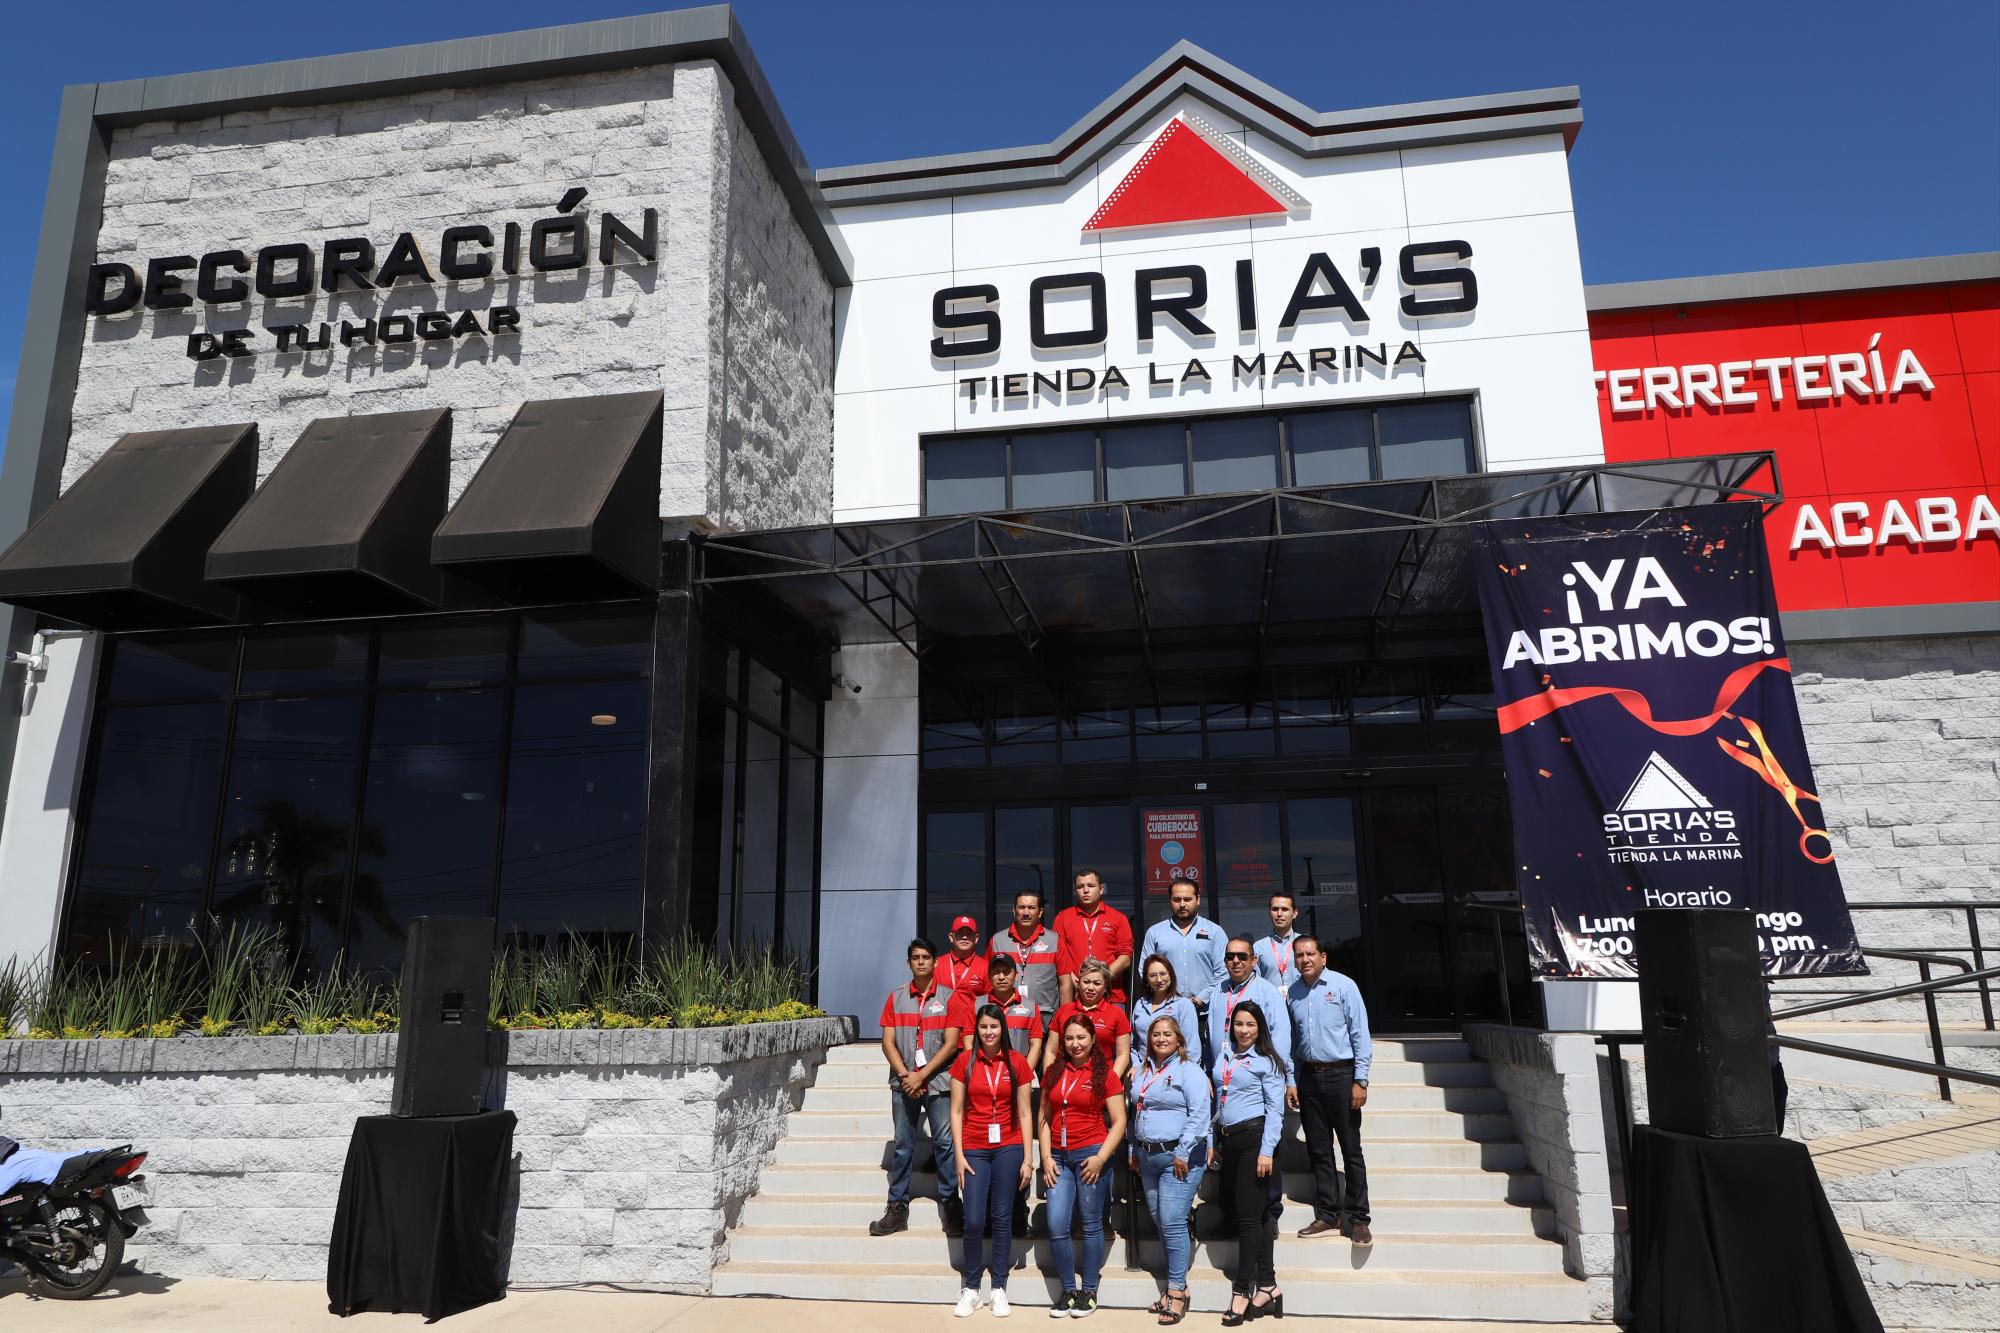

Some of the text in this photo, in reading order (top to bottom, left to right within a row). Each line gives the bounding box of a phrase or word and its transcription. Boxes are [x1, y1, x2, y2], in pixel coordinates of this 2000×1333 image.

[88, 187, 658, 316] DECORACIÓN
[930, 239, 1479, 360] SORIA'S
[186, 304, 521, 361] DE TU HOGAR
[960, 339, 1427, 402] TIENDA LA MARINA
[1562, 556, 1688, 624] ¡YA
[1502, 616, 1776, 670] ABRIMOS!
[1147, 821, 1199, 832] CUBREBOCAS
[1602, 810, 1737, 833] SORIA'S
[1606, 831, 1739, 846] TIENDA
[1608, 848, 1743, 864] TIENDA LA MARINA
[1322, 884, 1355, 894] ENTRADA
[1644, 885, 1732, 908] Horario
[1579, 914, 1635, 934] Lun
